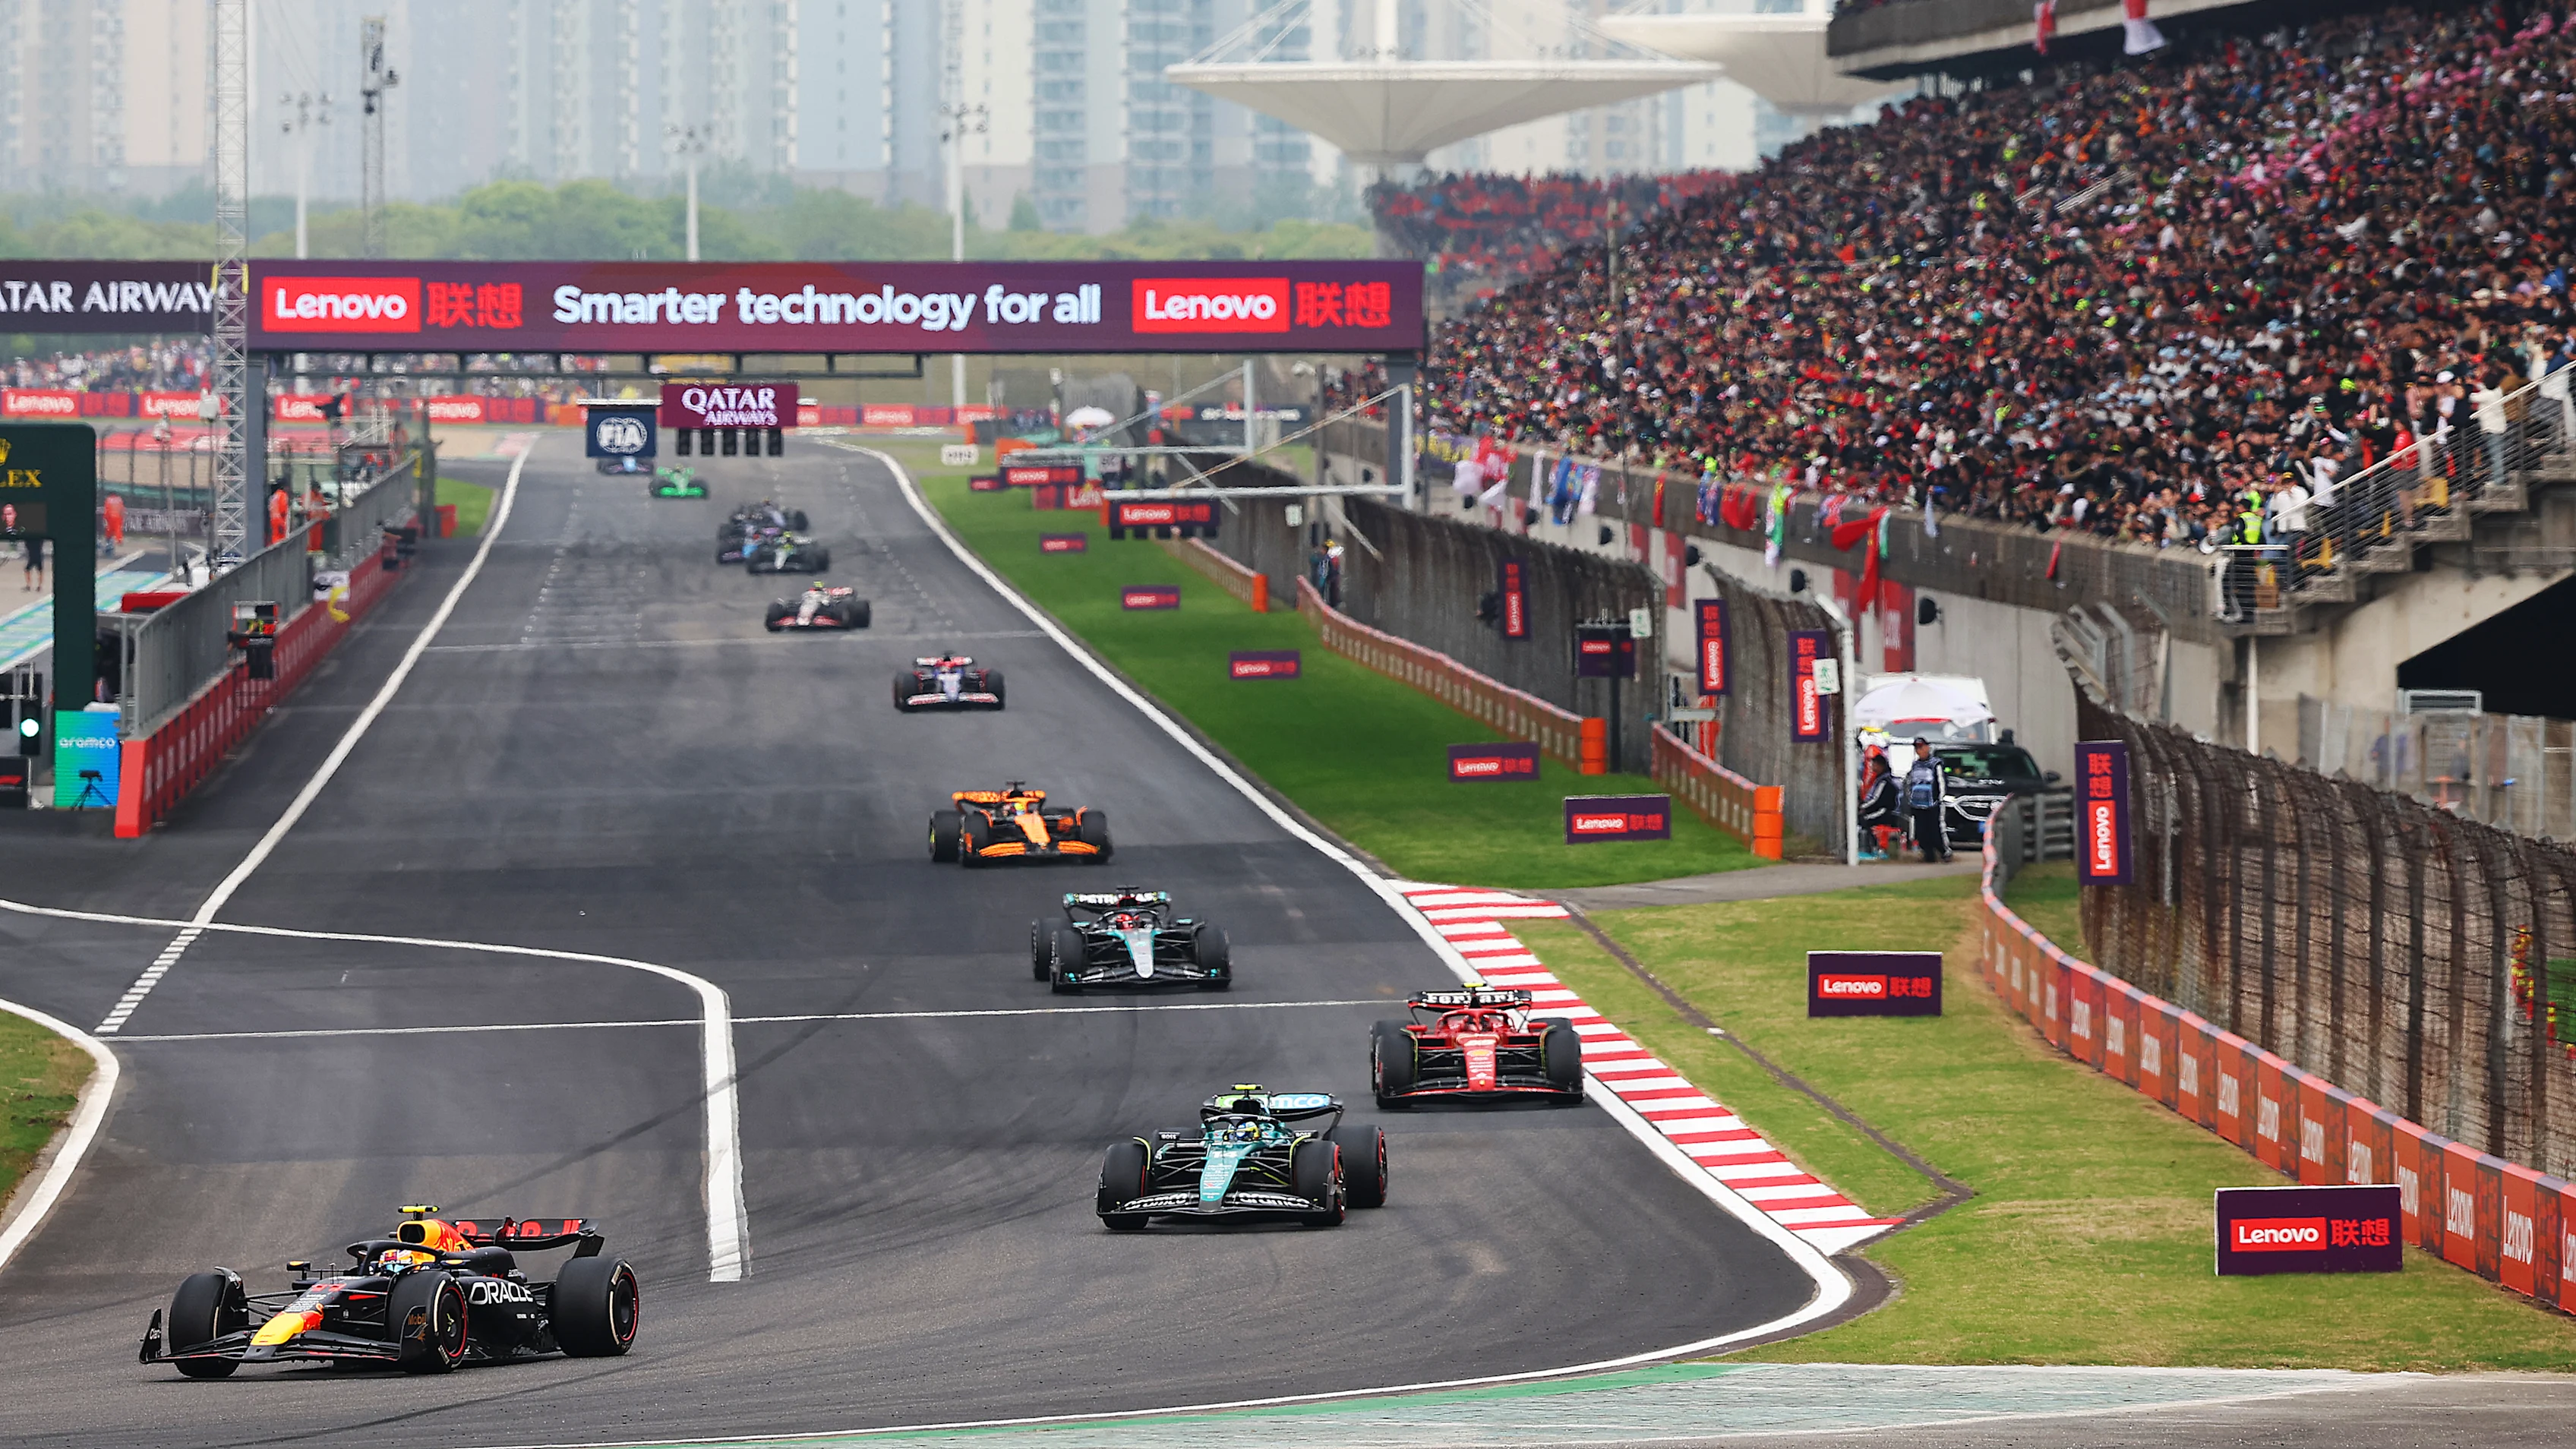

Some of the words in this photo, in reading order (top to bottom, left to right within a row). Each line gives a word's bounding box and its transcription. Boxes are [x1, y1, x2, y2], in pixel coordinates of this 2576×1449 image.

[0, 281, 74, 313] TAR
[276, 287, 408, 320] Lenovo
[427, 282, 523, 329] 联想
[552, 284, 727, 325] Smarter
[737, 283, 977, 332] technology
[983, 283, 1049, 325] for
[1053, 283, 1102, 324] all
[1144, 289, 1277, 320] Lenovo
[1295, 281, 1391, 328] 联想
[681, 387, 776, 415] QATAR
[703, 409, 778, 426] AIRWAYS
[601, 424, 641, 446] FIA
[1801, 679, 1816, 731] Lenovo
[59, 737, 115, 749] aramco
[1576, 816, 1624, 831] Lenovo
[2095, 806, 2113, 871] Lenovo
[1823, 979, 1883, 995] Lenovo
[1889, 976, 1933, 999] 联想
[2238, 1224, 2319, 1245] Lenovo
[2330, 1218, 2391, 1248] 联想
[468, 1281, 534, 1305] ORACLE
